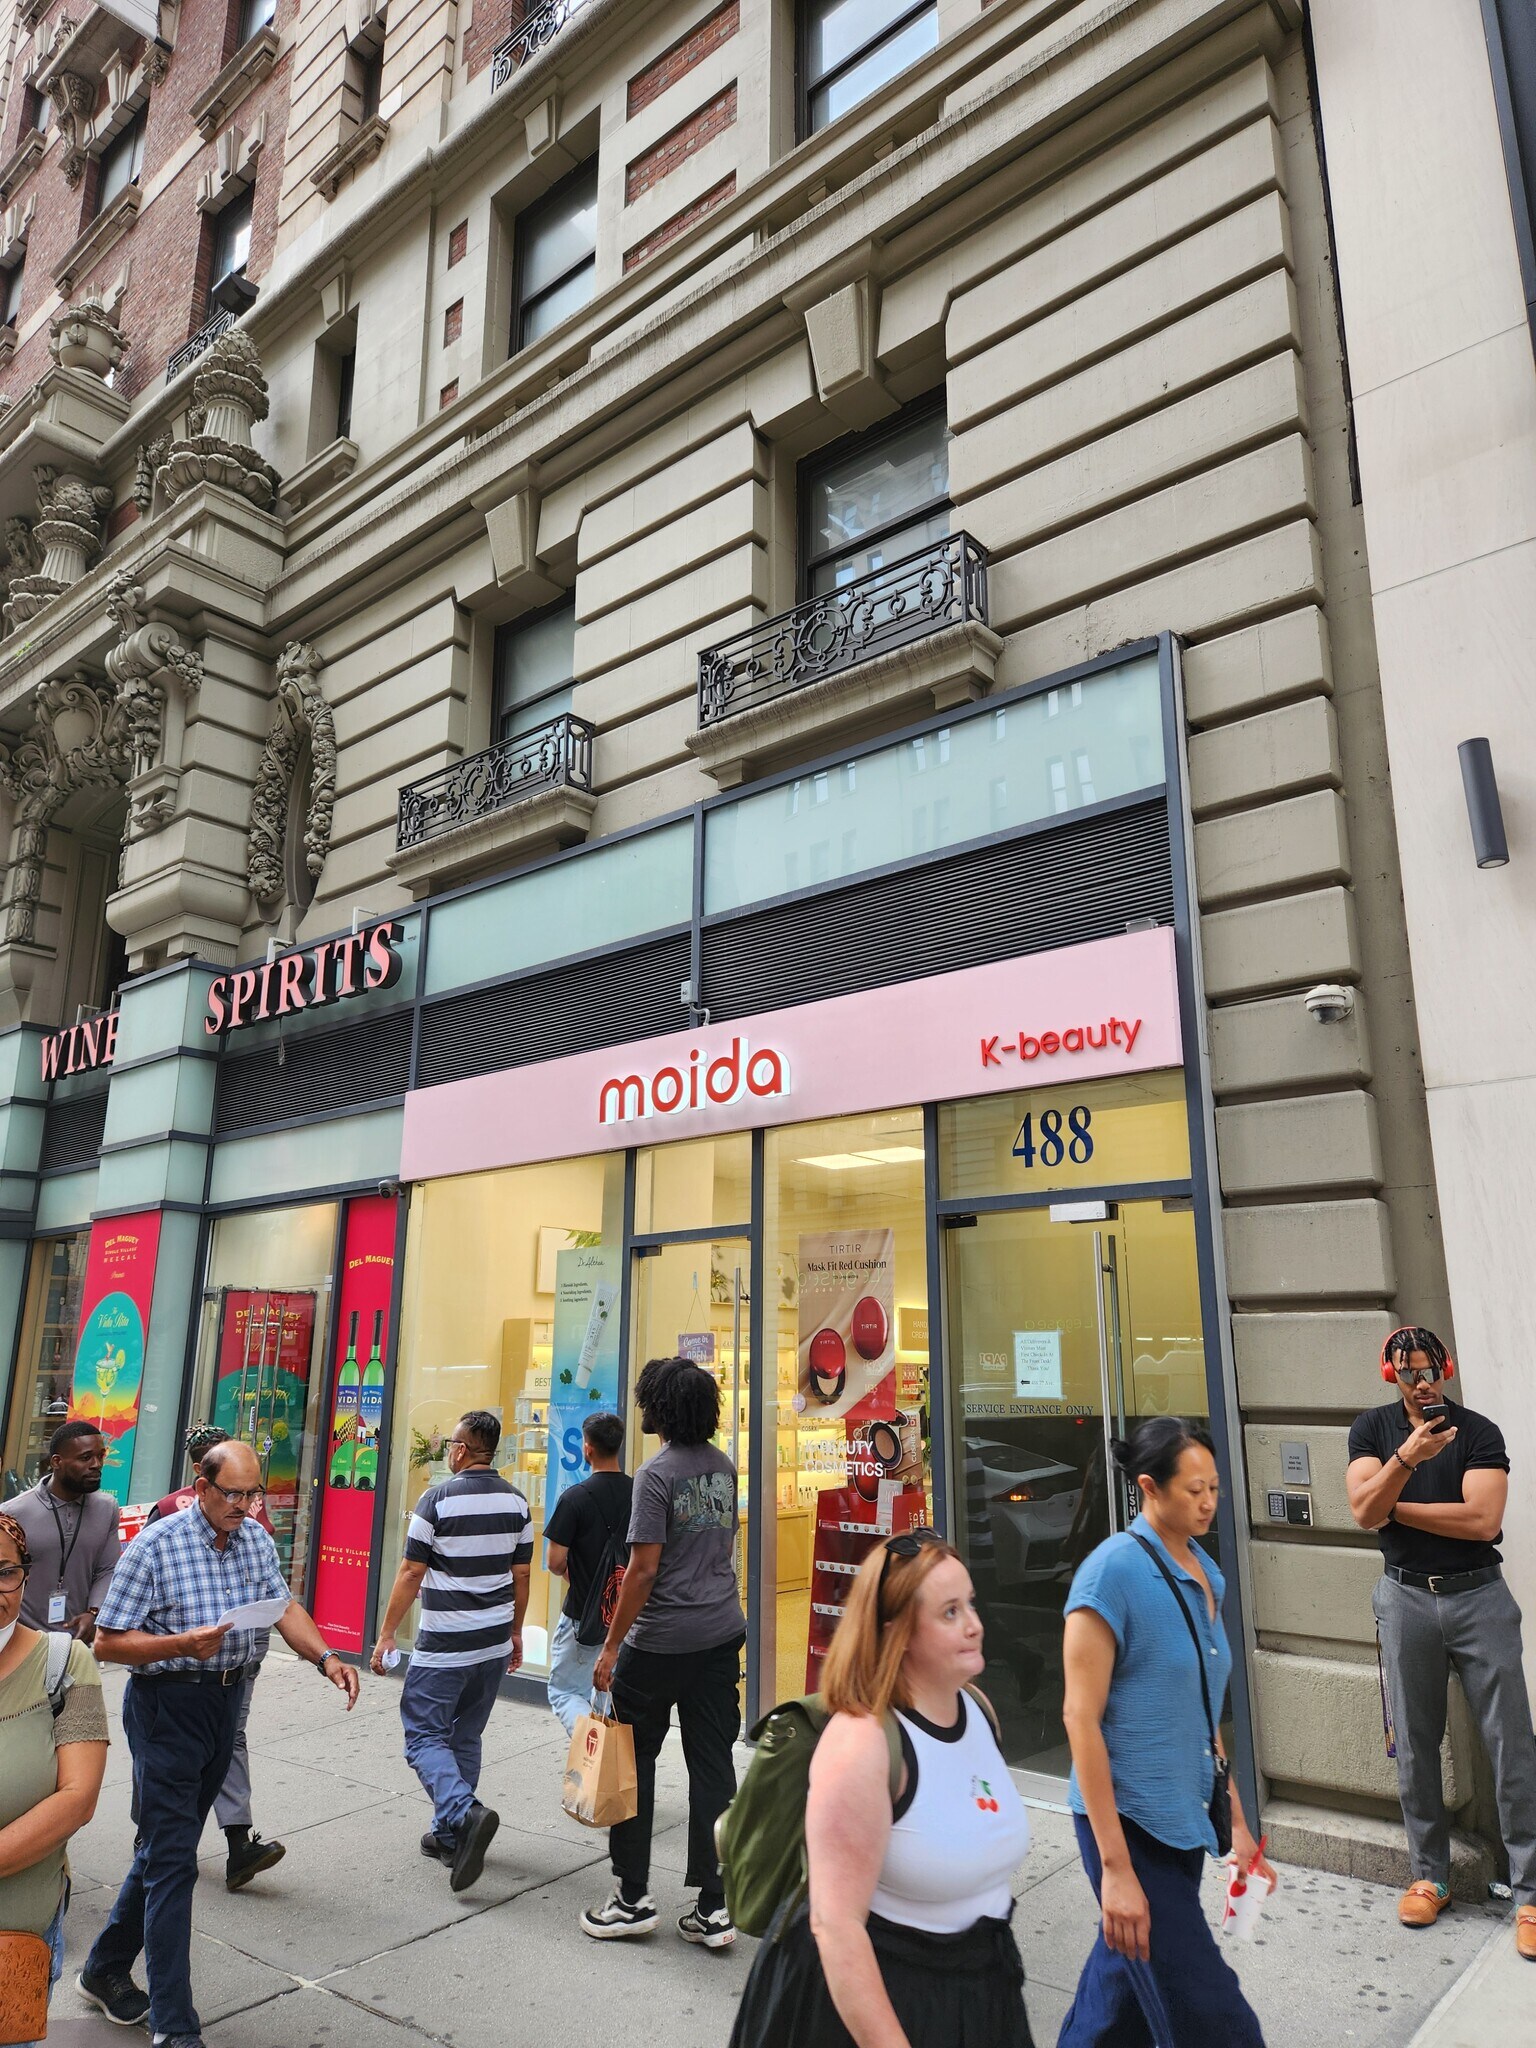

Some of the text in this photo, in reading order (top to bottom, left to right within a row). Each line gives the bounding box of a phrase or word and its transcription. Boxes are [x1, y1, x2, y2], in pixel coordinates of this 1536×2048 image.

[204, 922, 403, 1035] SPIRITS
[980, 1017, 1142, 1067] K-beauty
[599, 1036, 791, 1125] moida
[1012, 1105, 1094, 1168] 488
[829, 1243, 862, 1255] TIRTIR
[349, 1258, 363, 1269] DEL
[807, 1258, 887, 1272] Mask Fit Red Cushion
[687, 1350, 707, 1361] OPEN
[337, 1396, 358, 1404] VIDA
[361, 1396, 383, 1404] VIDA
[966, 1404, 1094, 1415] SERVICE ENTRANCE ONLY
[805, 1439, 874, 1456] K-BEAUTY
[805, 1460, 884, 1477] COSMETICS
[1127, 1479, 1137, 1517] USH
[322, 1544, 371, 1557] SINGLE VILLAGE
[321, 1554, 370, 1568] MEZCAL
